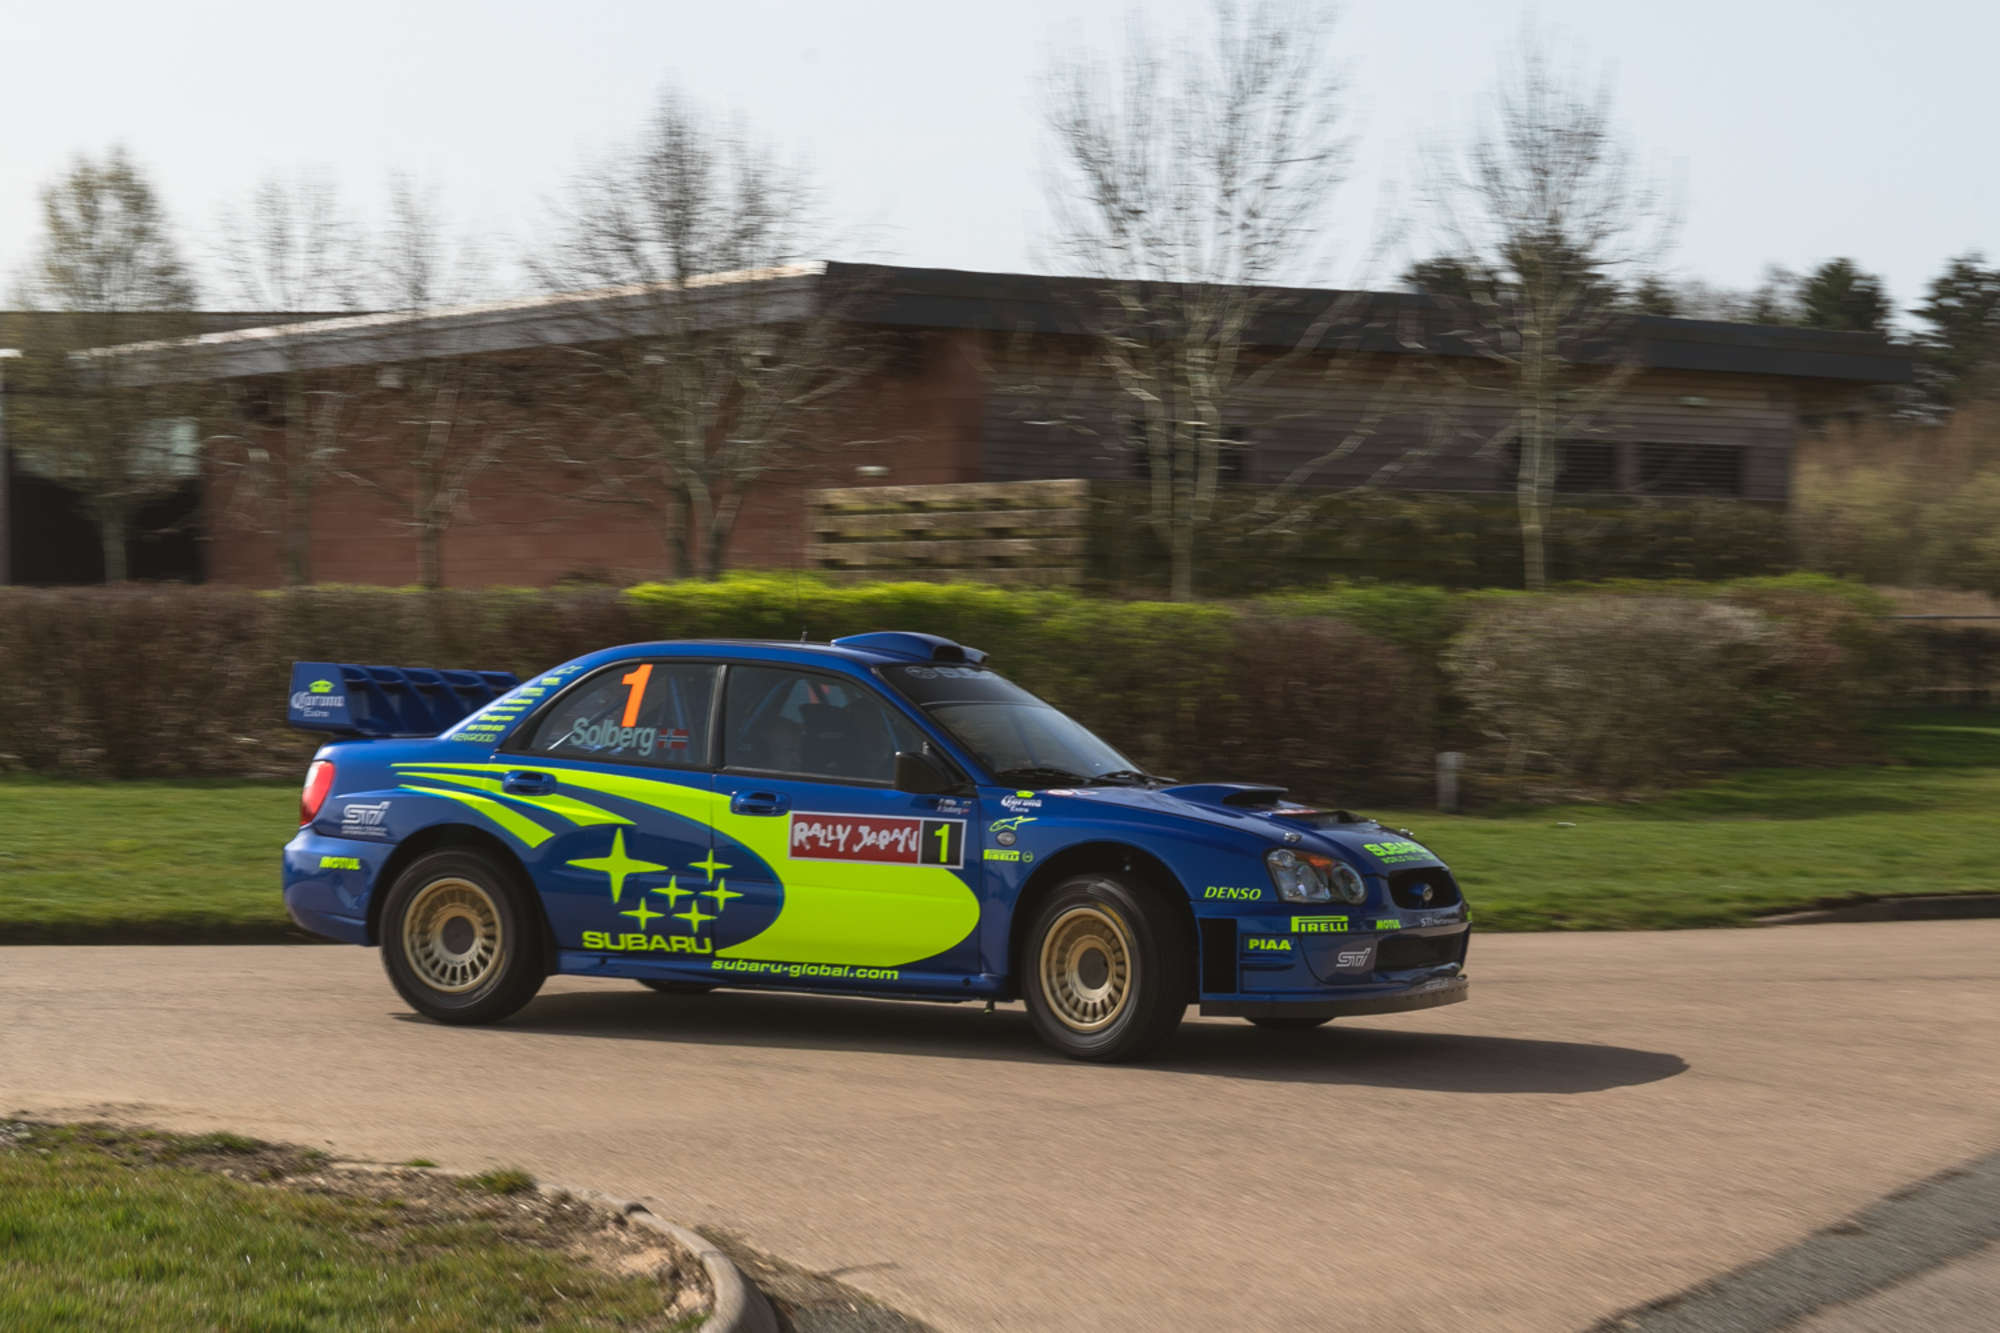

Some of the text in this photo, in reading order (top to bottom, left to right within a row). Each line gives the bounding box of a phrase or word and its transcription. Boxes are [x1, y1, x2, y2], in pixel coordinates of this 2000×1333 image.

[291, 691, 344, 709] Corona
[621, 664, 653, 727] 1
[570, 717, 656, 756] Solberg
[1001, 795, 1042, 807] Corona
[793, 822, 852, 852] RALLY
[934, 823, 950, 863] 1
[1203, 886, 1261, 900] DENSO
[1290, 916, 1348, 932] PIRELLI
[1376, 919, 1401, 930] MOTUL
[582, 930, 712, 954] SUBARU
[1249, 938, 1291, 950] PIAA
[711, 958, 899, 980] subaru-global.com
